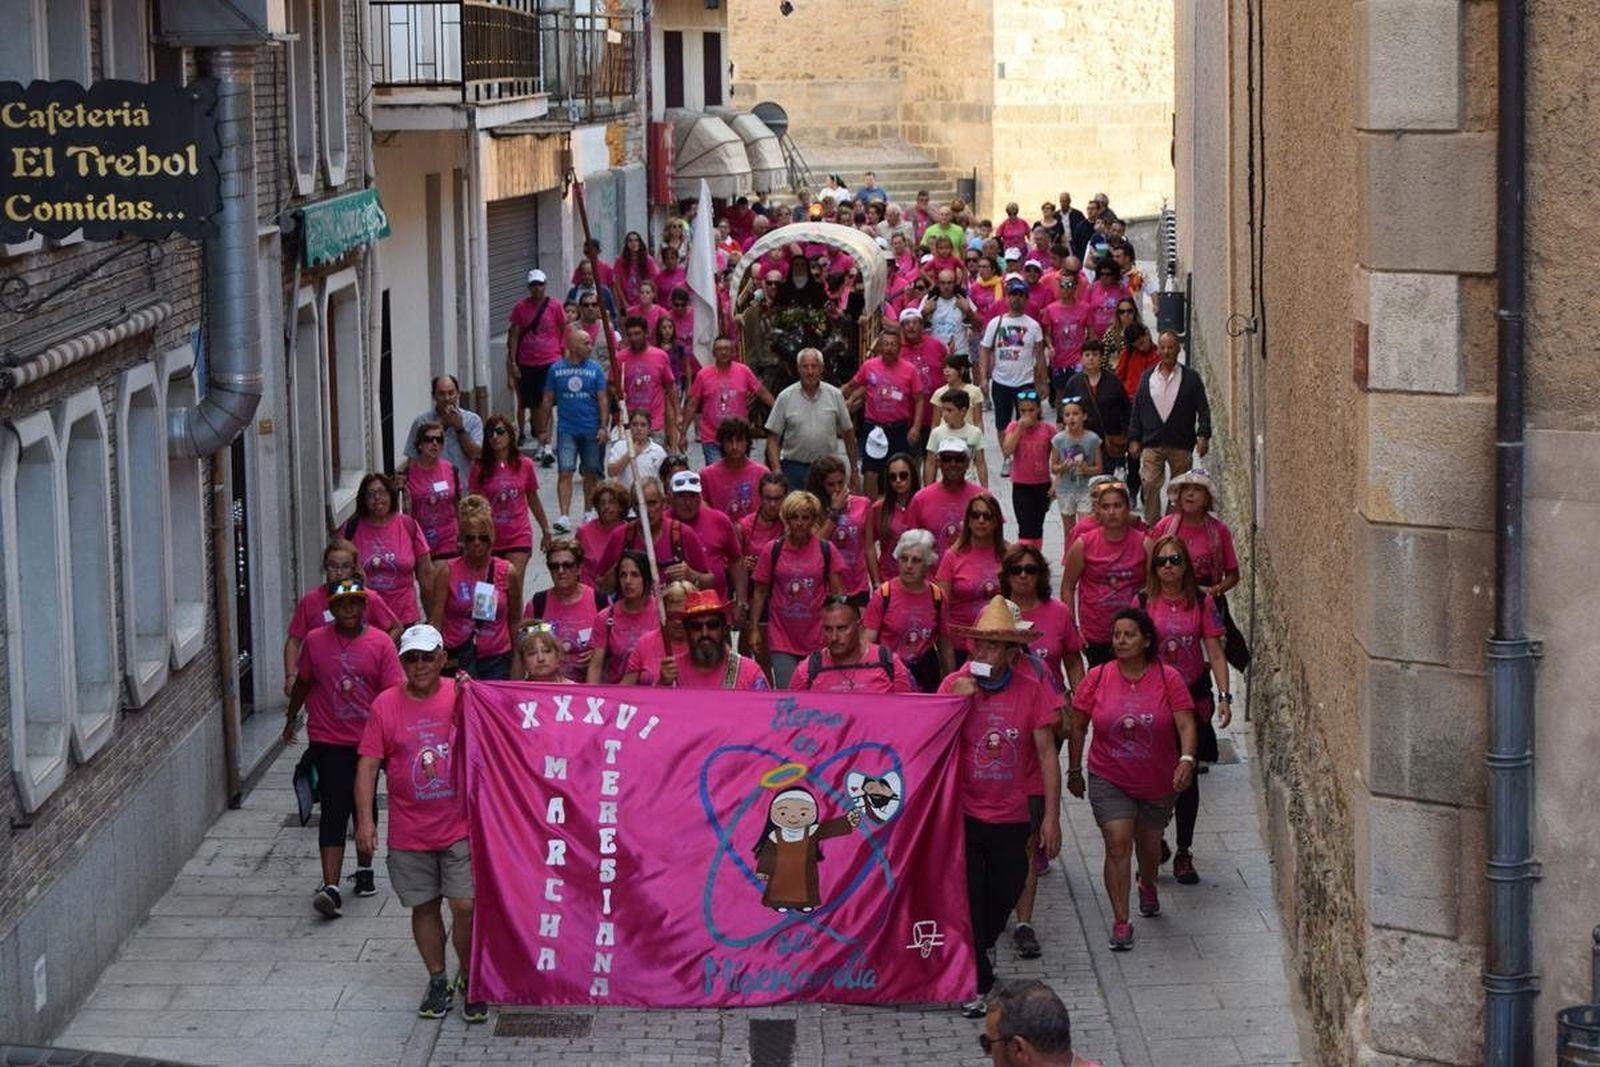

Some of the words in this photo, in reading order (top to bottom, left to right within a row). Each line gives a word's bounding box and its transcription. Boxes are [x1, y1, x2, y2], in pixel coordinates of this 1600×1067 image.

[11, 147, 55, 177] El
[66, 145, 199, 177] Trebol
[537, 755, 568, 972] MARCHA
[590, 739, 622, 997] TERESIANA
